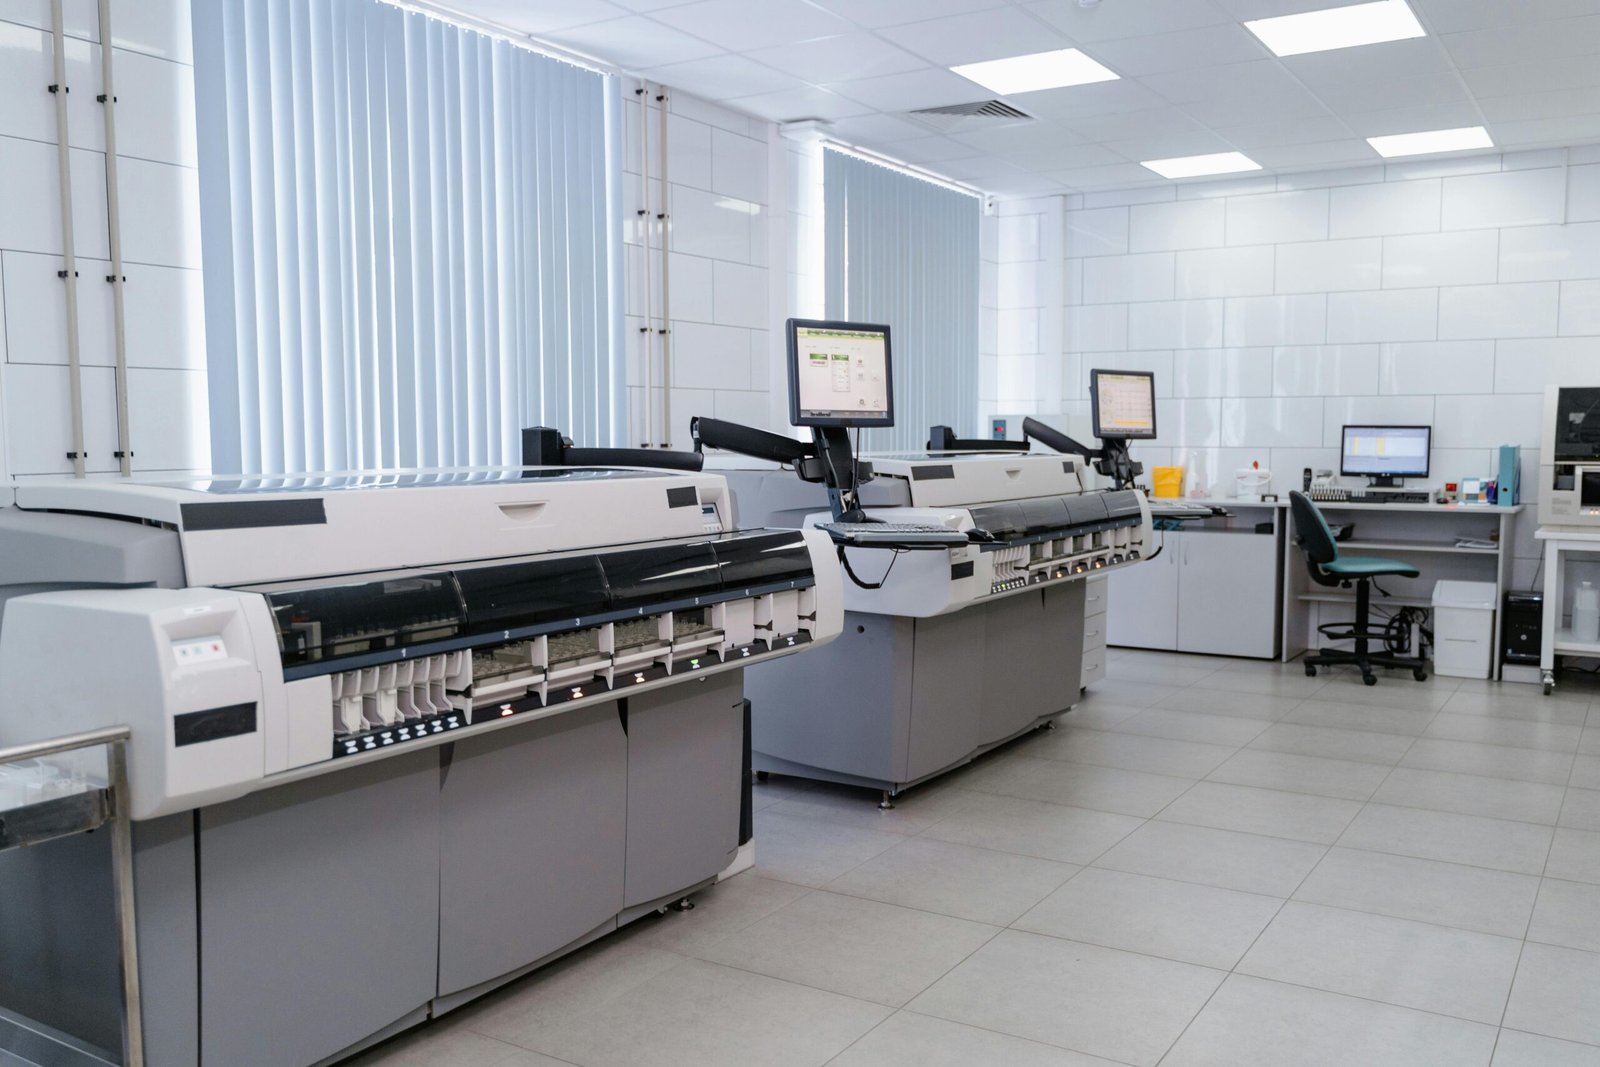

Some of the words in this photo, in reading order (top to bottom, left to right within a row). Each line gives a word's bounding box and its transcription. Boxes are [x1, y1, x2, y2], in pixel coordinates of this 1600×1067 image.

[401, 648, 406, 658] 1
[504, 630, 509, 639] 2
[575, 617, 580, 626] 3
[638, 607, 643, 615] 4
[695, 597, 699, 605] 5
[745, 588, 749, 596] 6
